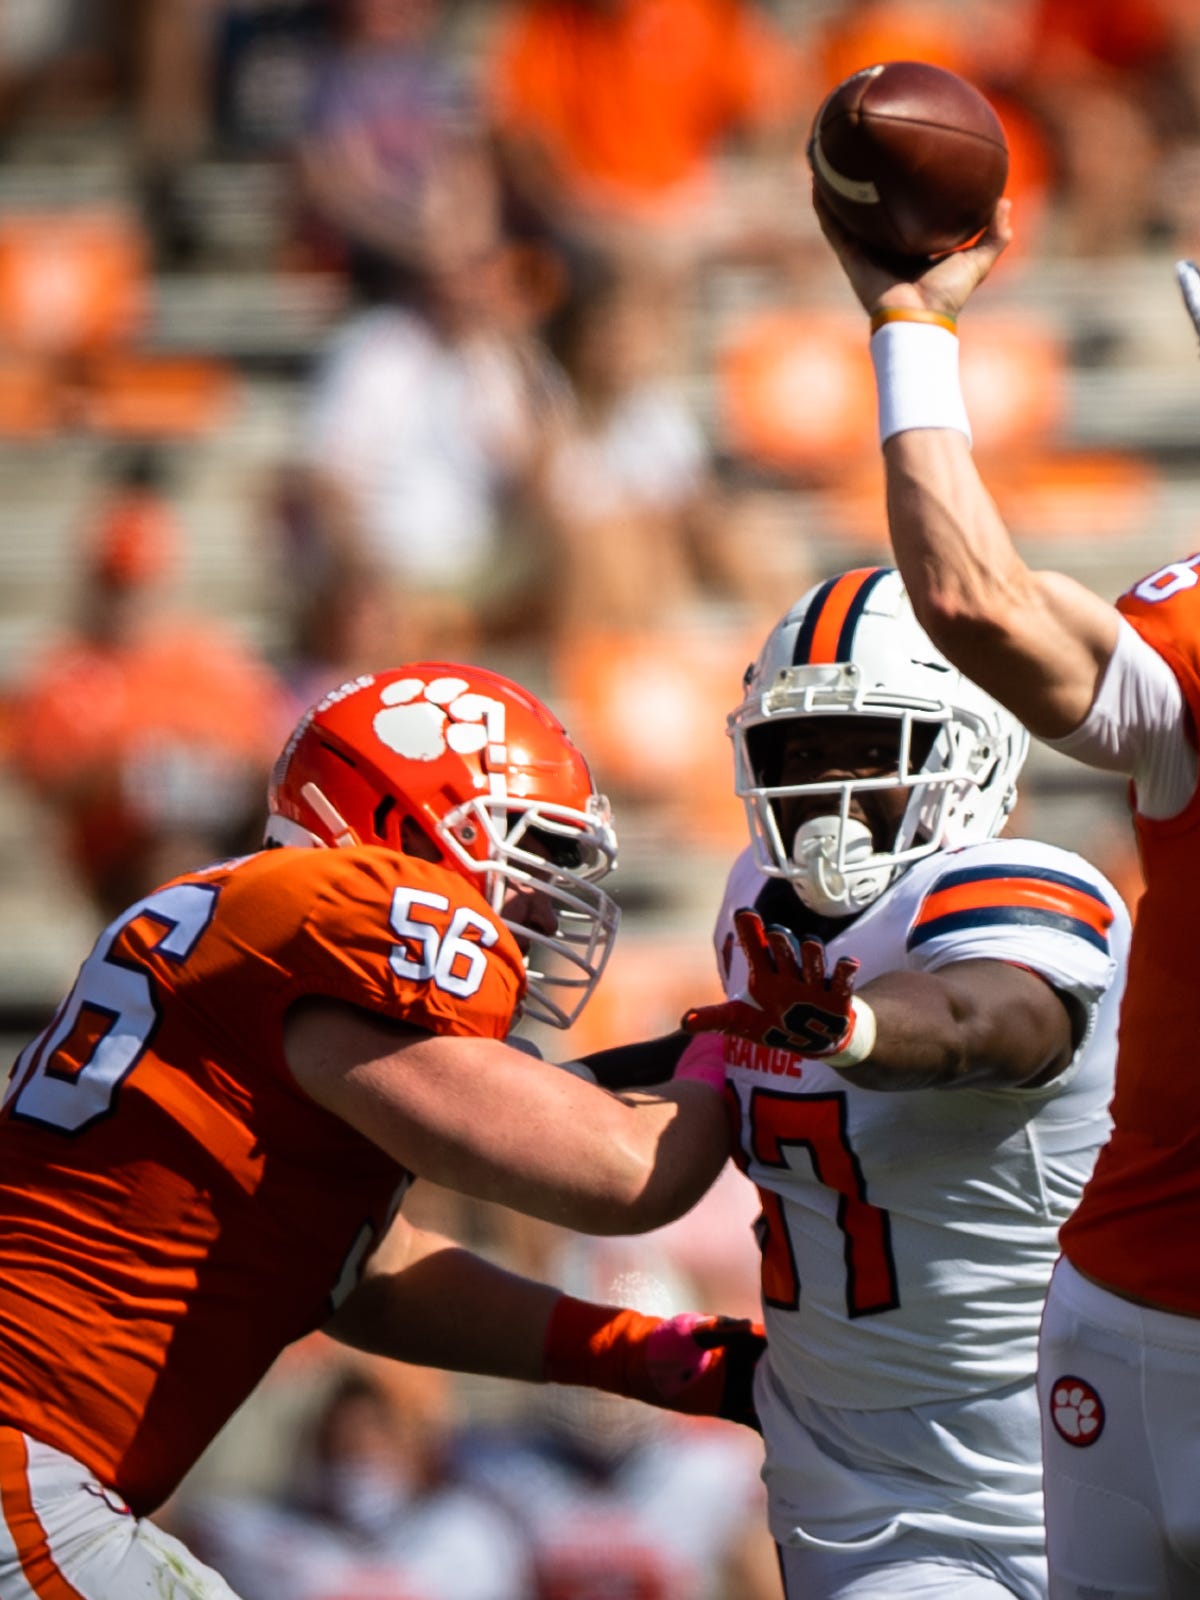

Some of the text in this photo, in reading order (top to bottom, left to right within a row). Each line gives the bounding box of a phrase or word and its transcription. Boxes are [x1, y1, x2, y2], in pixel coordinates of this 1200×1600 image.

[388, 886, 500, 1000] 56
[4, 881, 222, 1141] 6
[762, 1002, 848, 1053] S
[725, 1035, 803, 1078] RANGE
